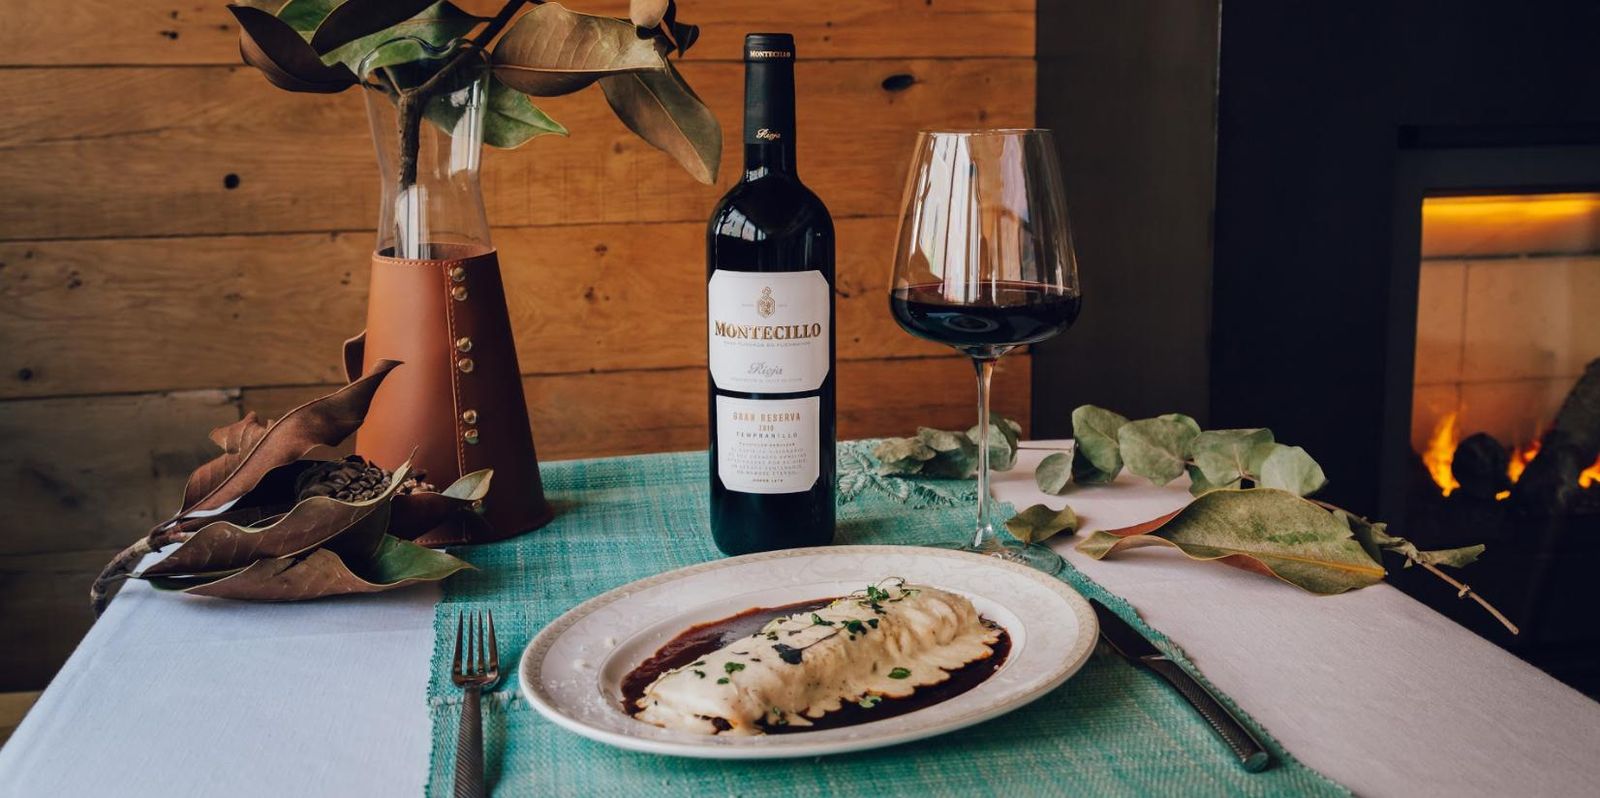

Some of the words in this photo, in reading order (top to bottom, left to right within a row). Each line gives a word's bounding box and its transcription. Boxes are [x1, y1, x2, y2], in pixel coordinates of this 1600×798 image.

[749, 50, 791, 58] MONTECILLO
[755, 128, 781, 140] Rioja
[714, 320, 822, 340] MONTECILLO
[747, 361, 784, 377] Rioja
[760, 411, 801, 422] RESERVA
